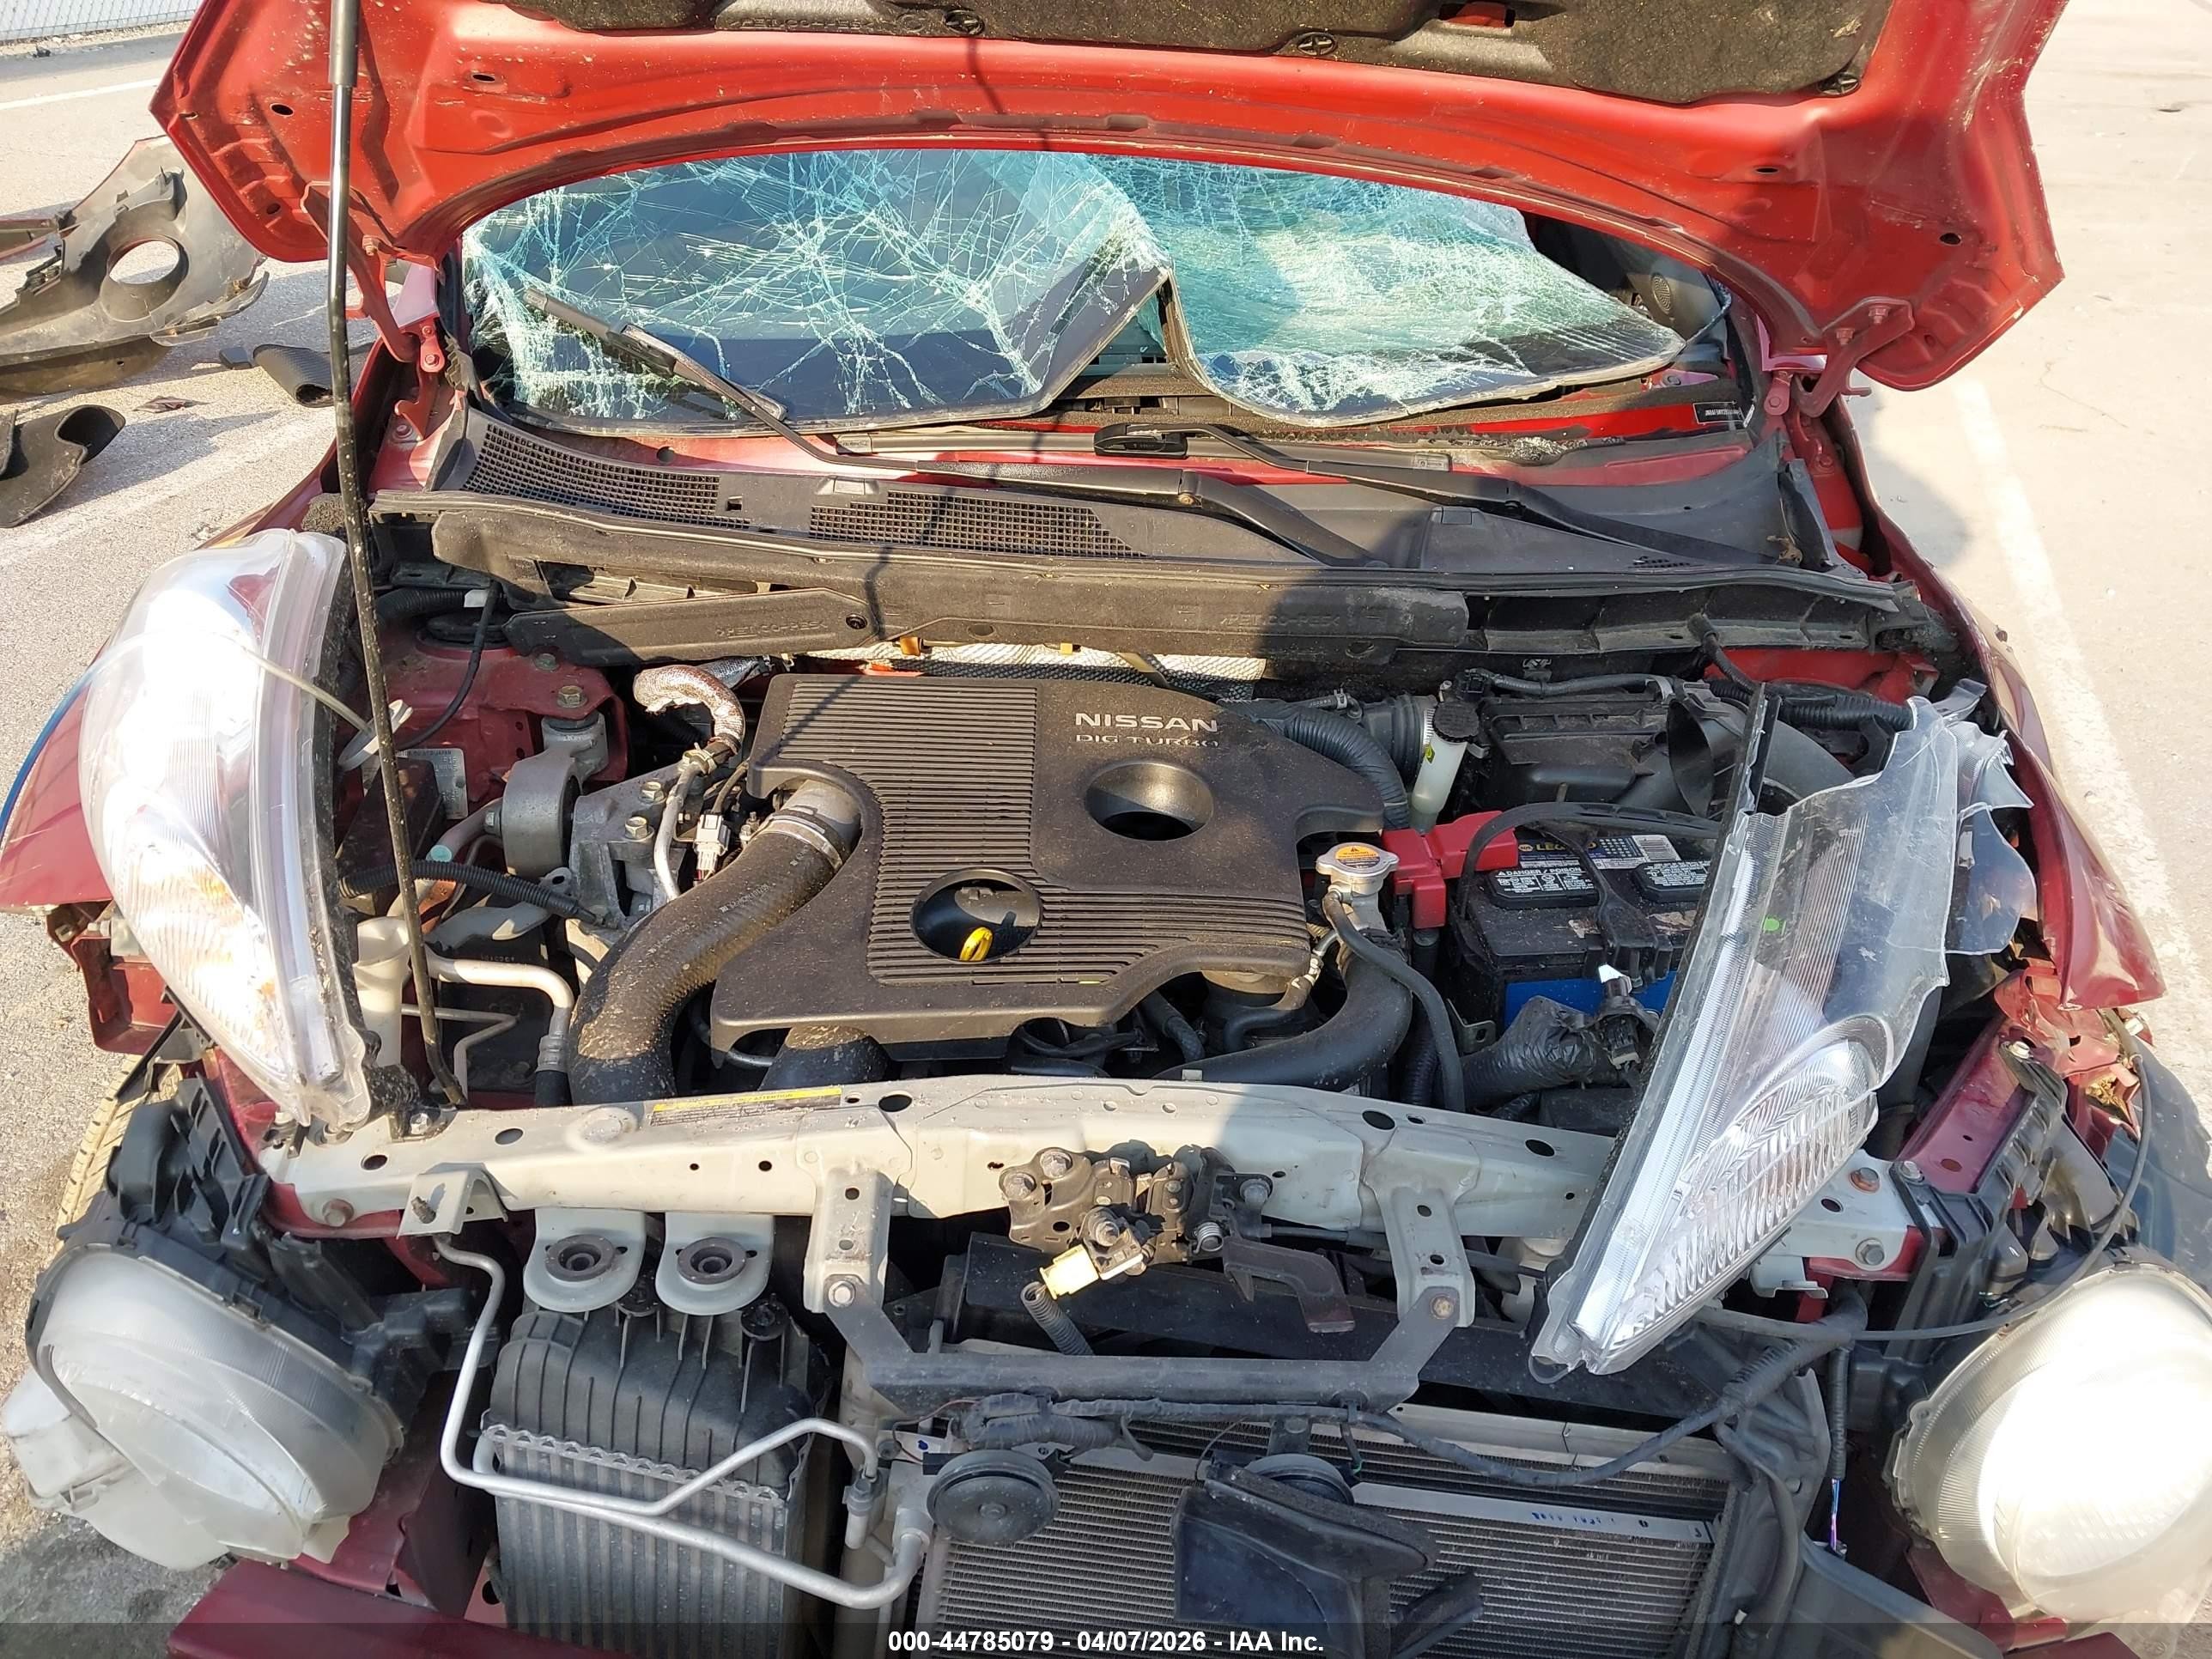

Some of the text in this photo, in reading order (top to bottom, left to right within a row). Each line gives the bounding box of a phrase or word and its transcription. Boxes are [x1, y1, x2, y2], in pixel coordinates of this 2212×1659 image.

[1075, 713, 1218, 732] NISSAN
[1076, 734, 1219, 747] DIG TURBO
